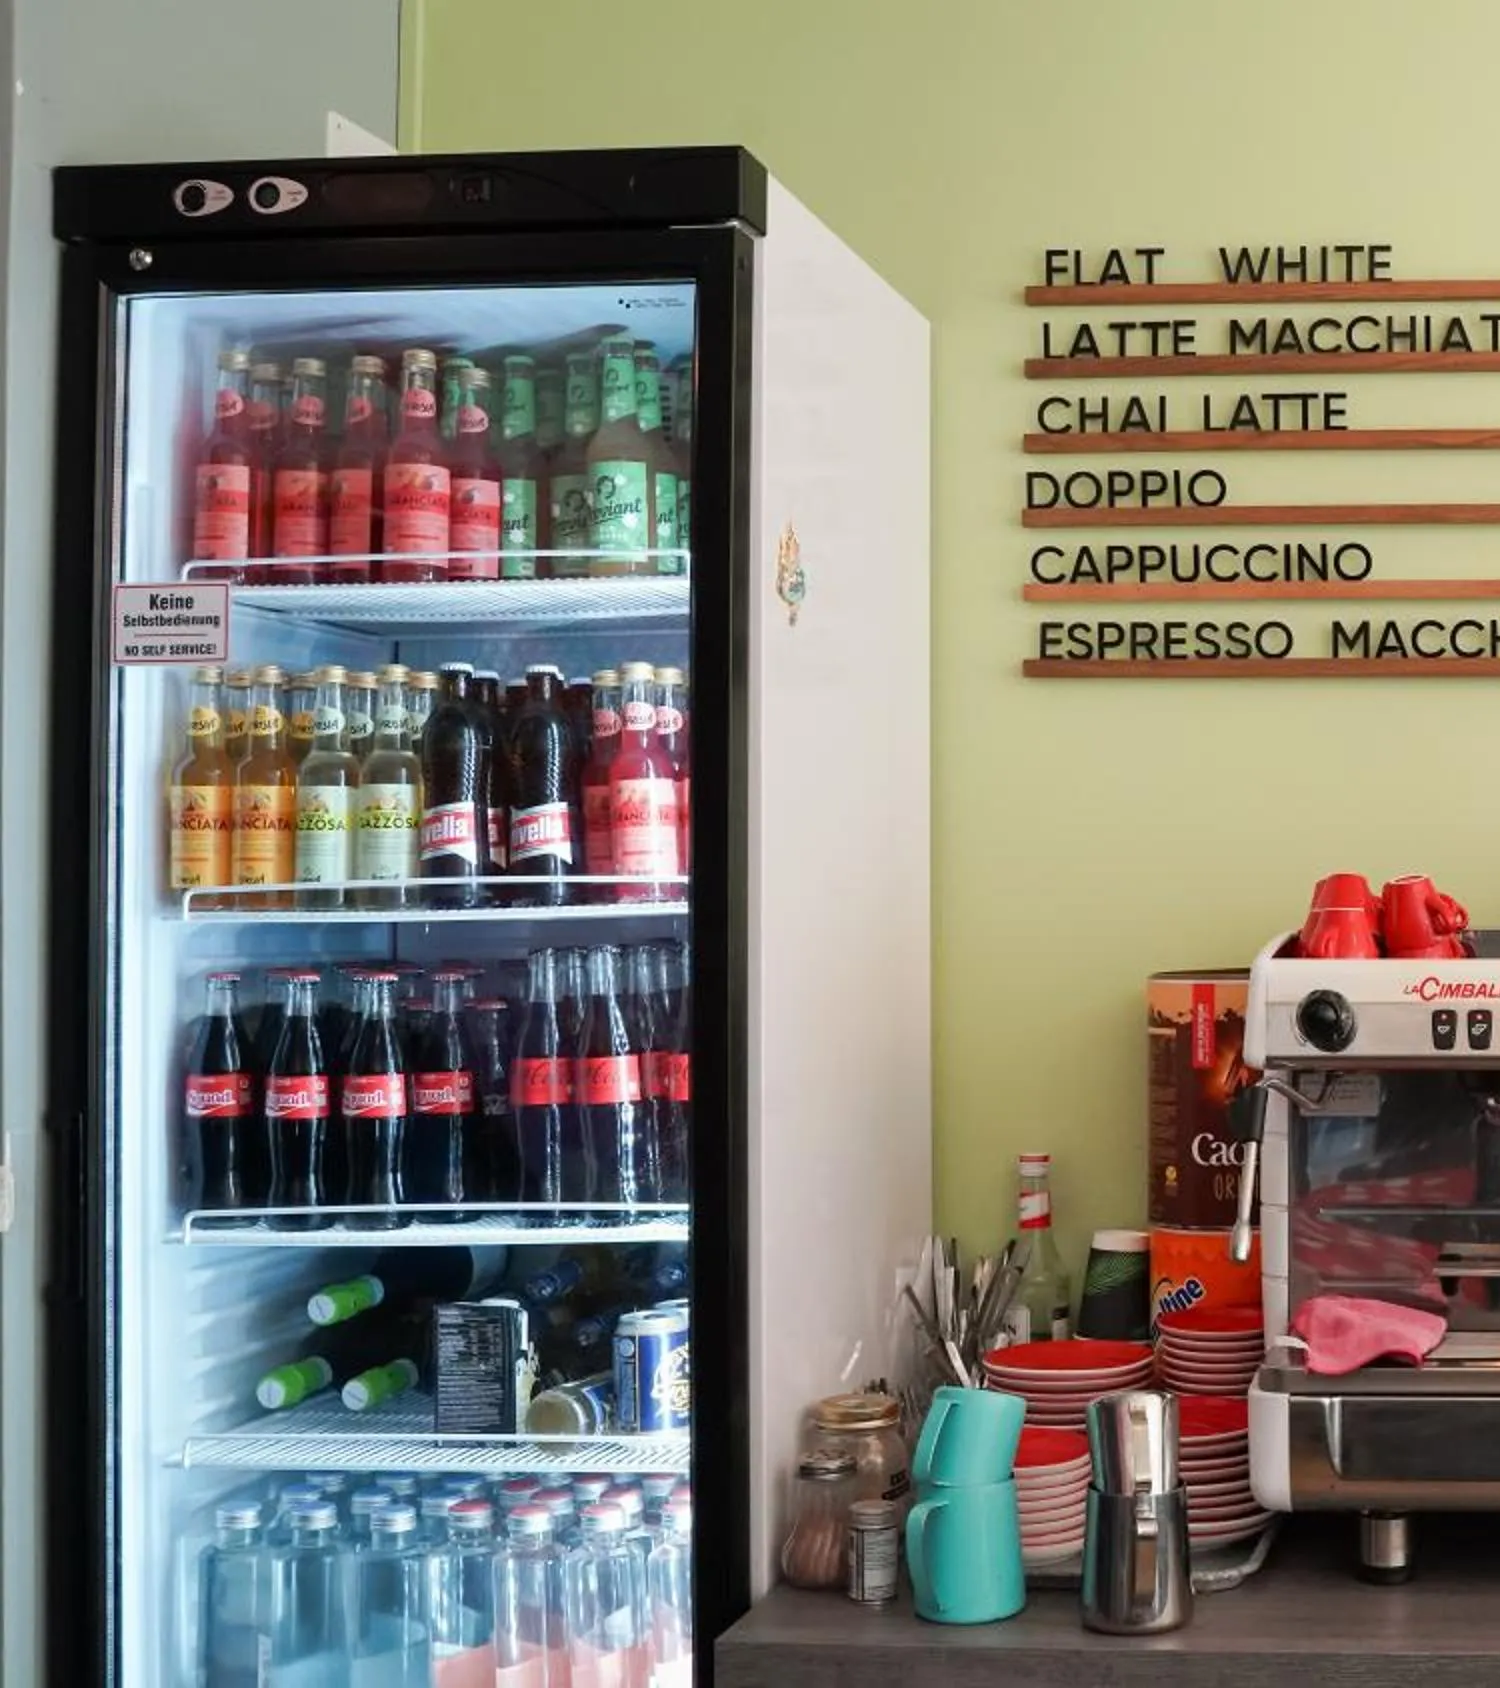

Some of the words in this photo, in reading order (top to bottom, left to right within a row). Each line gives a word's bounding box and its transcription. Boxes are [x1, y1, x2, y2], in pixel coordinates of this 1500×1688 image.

[1045, 248, 1165, 286] FLAT
[1219, 245, 1392, 283] WHITE
[1042, 320, 1196, 358] LATTE
[1037, 396, 1167, 435] CHAI
[1202, 393, 1348, 433] LATTE
[1026, 470, 1227, 509] DOPPIO
[1030, 543, 1373, 584] CAPPUCCINO
[123, 614, 221, 628] Selbstbedienung
[150, 593, 194, 611] Keine
[124, 645, 138, 657] NO
[142, 644, 166, 656] SELF
[1038, 622, 1294, 660] ESPRESSO
